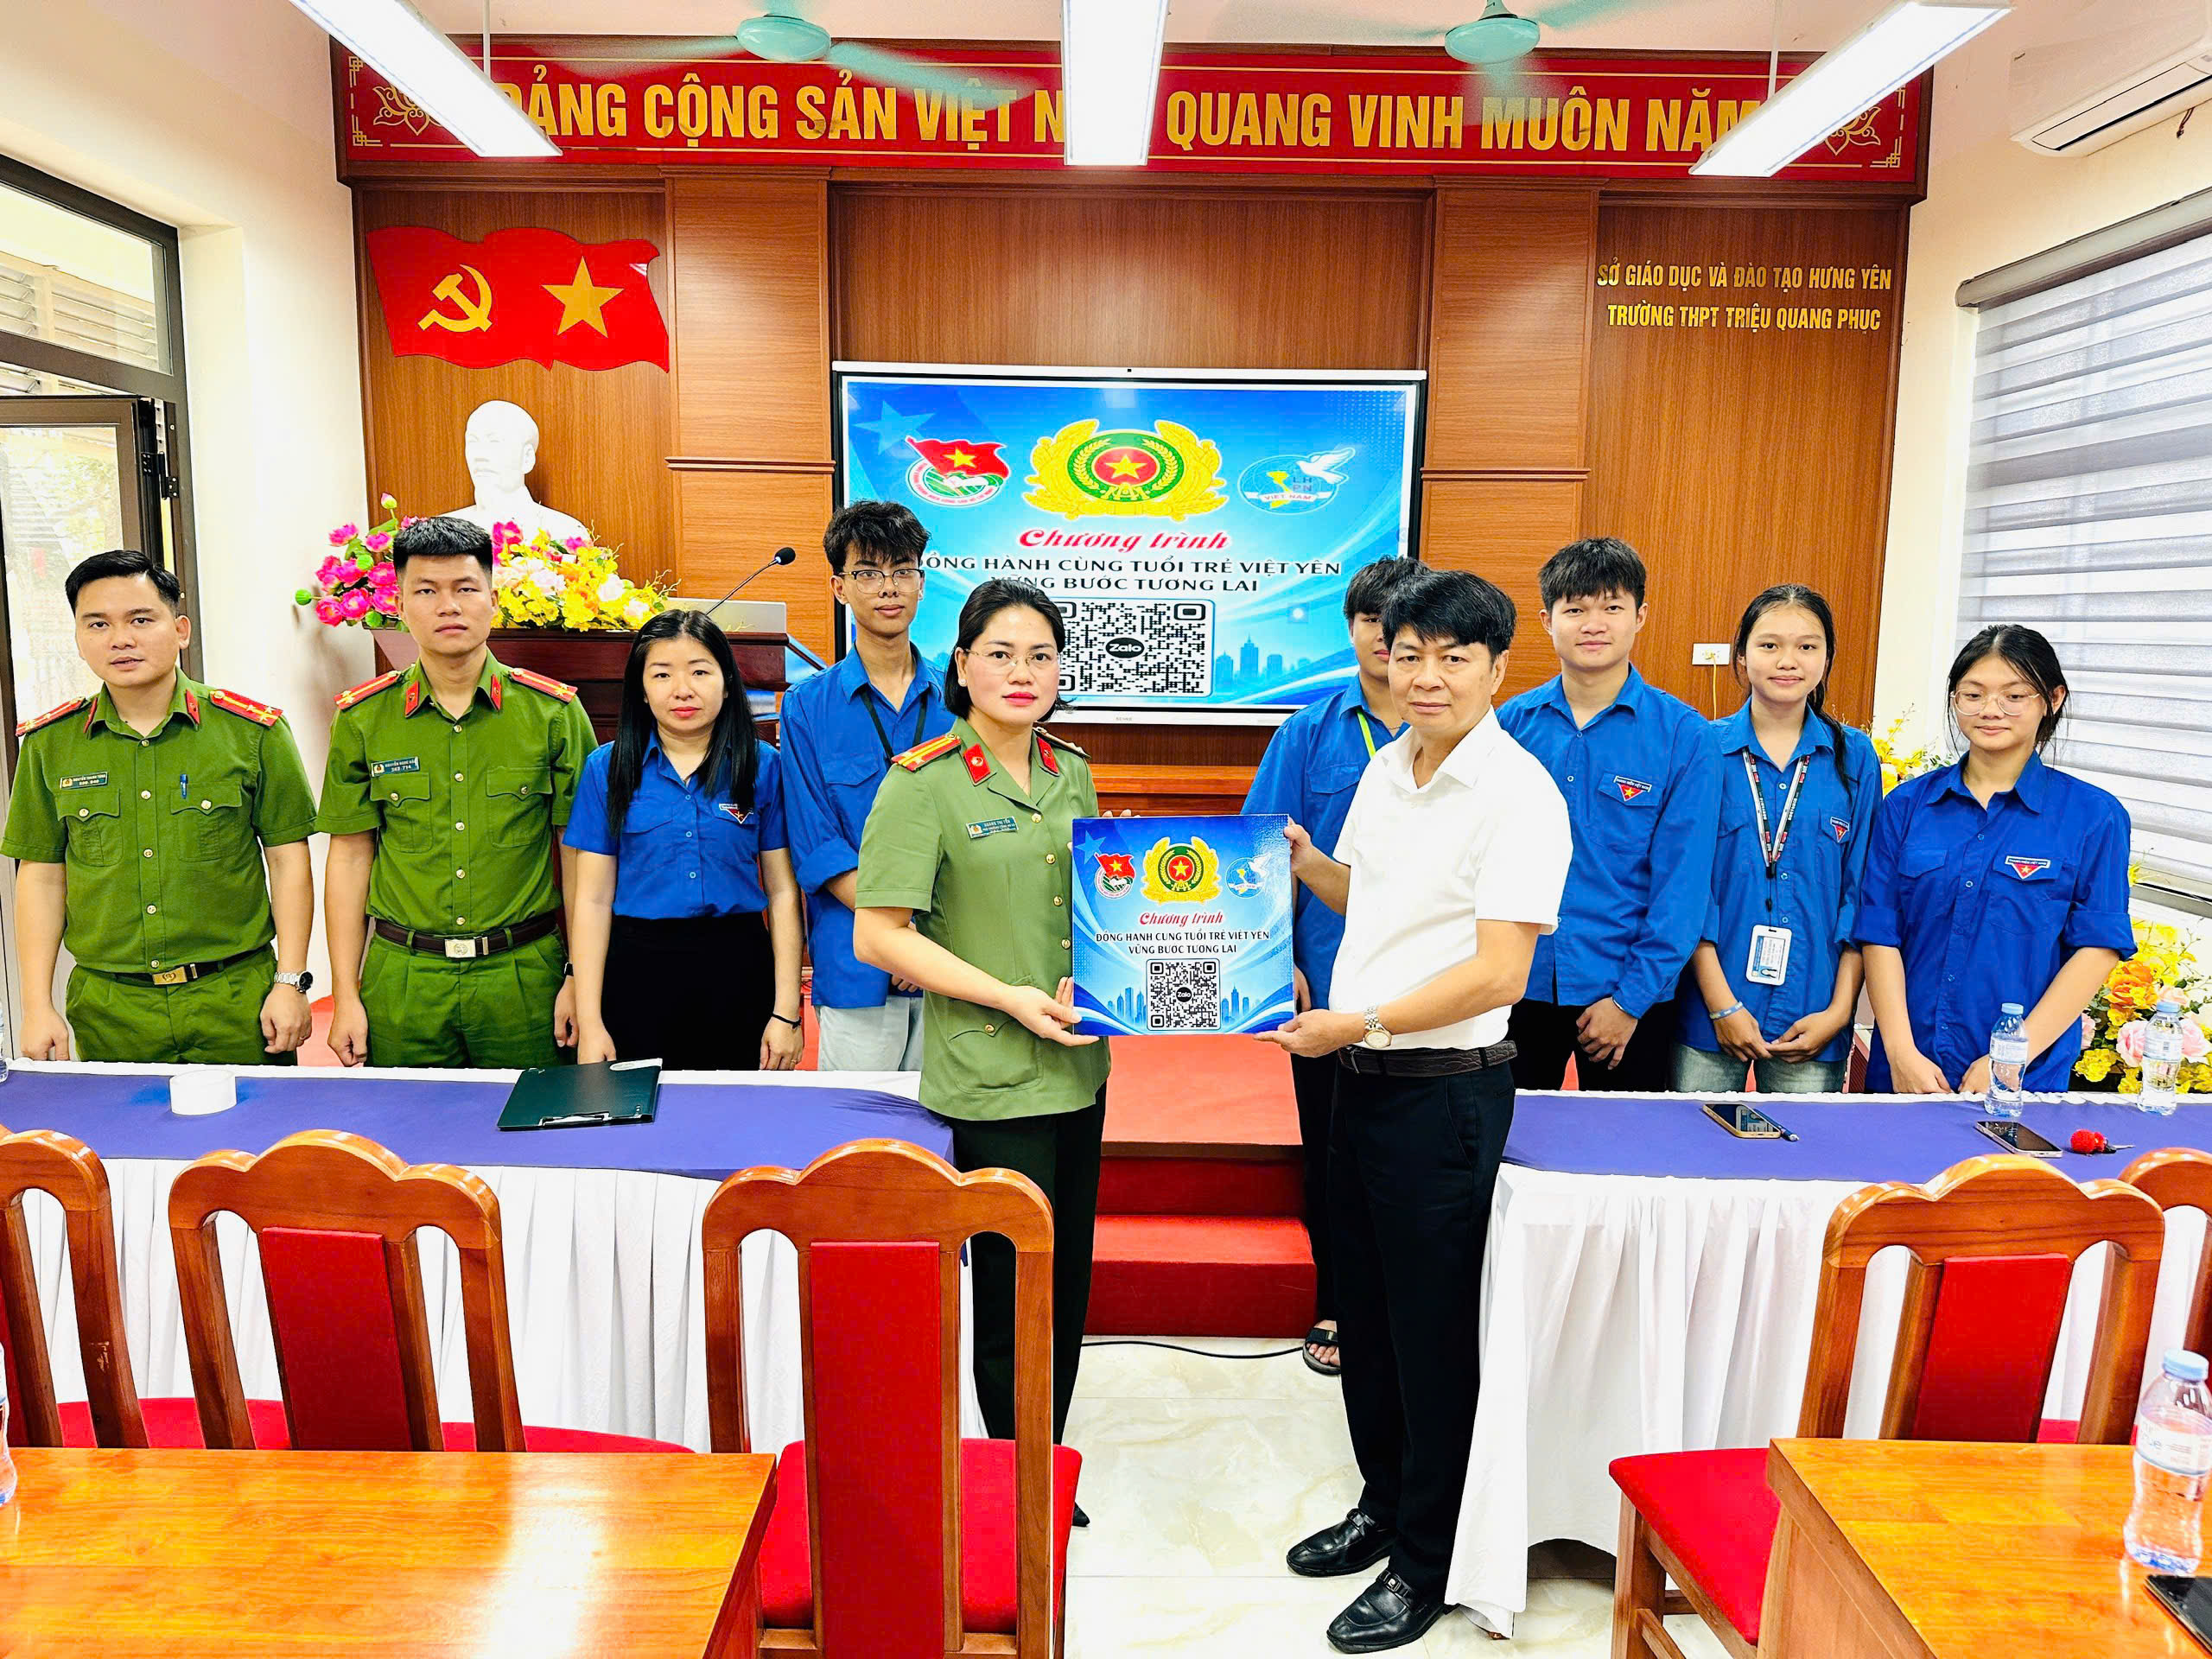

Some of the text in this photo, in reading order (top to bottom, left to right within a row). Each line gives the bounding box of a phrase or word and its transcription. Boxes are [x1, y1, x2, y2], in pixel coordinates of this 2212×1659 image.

[644, 73, 779, 147] CỘNG
[796, 69, 897, 140] SẢN
[913, 77, 1017, 150] VIỆT
[1166, 91, 1332, 151] QUANG
[1348, 94, 1464, 149] VINH
[1480, 86, 1630, 151] MUÔN
[1597, 257, 1891, 293] SỞ GIÁO DỤC VÀ ĐÀO TẠO HƯNG YÊN
[1607, 300, 1880, 334] TRƯỜNG THPT TRIỆU QUANG PHỤC
[1020, 529, 1229, 552] Chương trình
[920, 551, 1340, 576] ỒNG HÀNH CÙNG TUỔI TRẺ VIỆT YÊN
[1064, 575, 1128, 590] BƯỚC
[1135, 578, 1213, 591] TƯƠNG
[1223, 581, 1257, 591] LAI
[1109, 643, 1142, 652] Zalo
[1222, 944, 1236, 953] LAI
